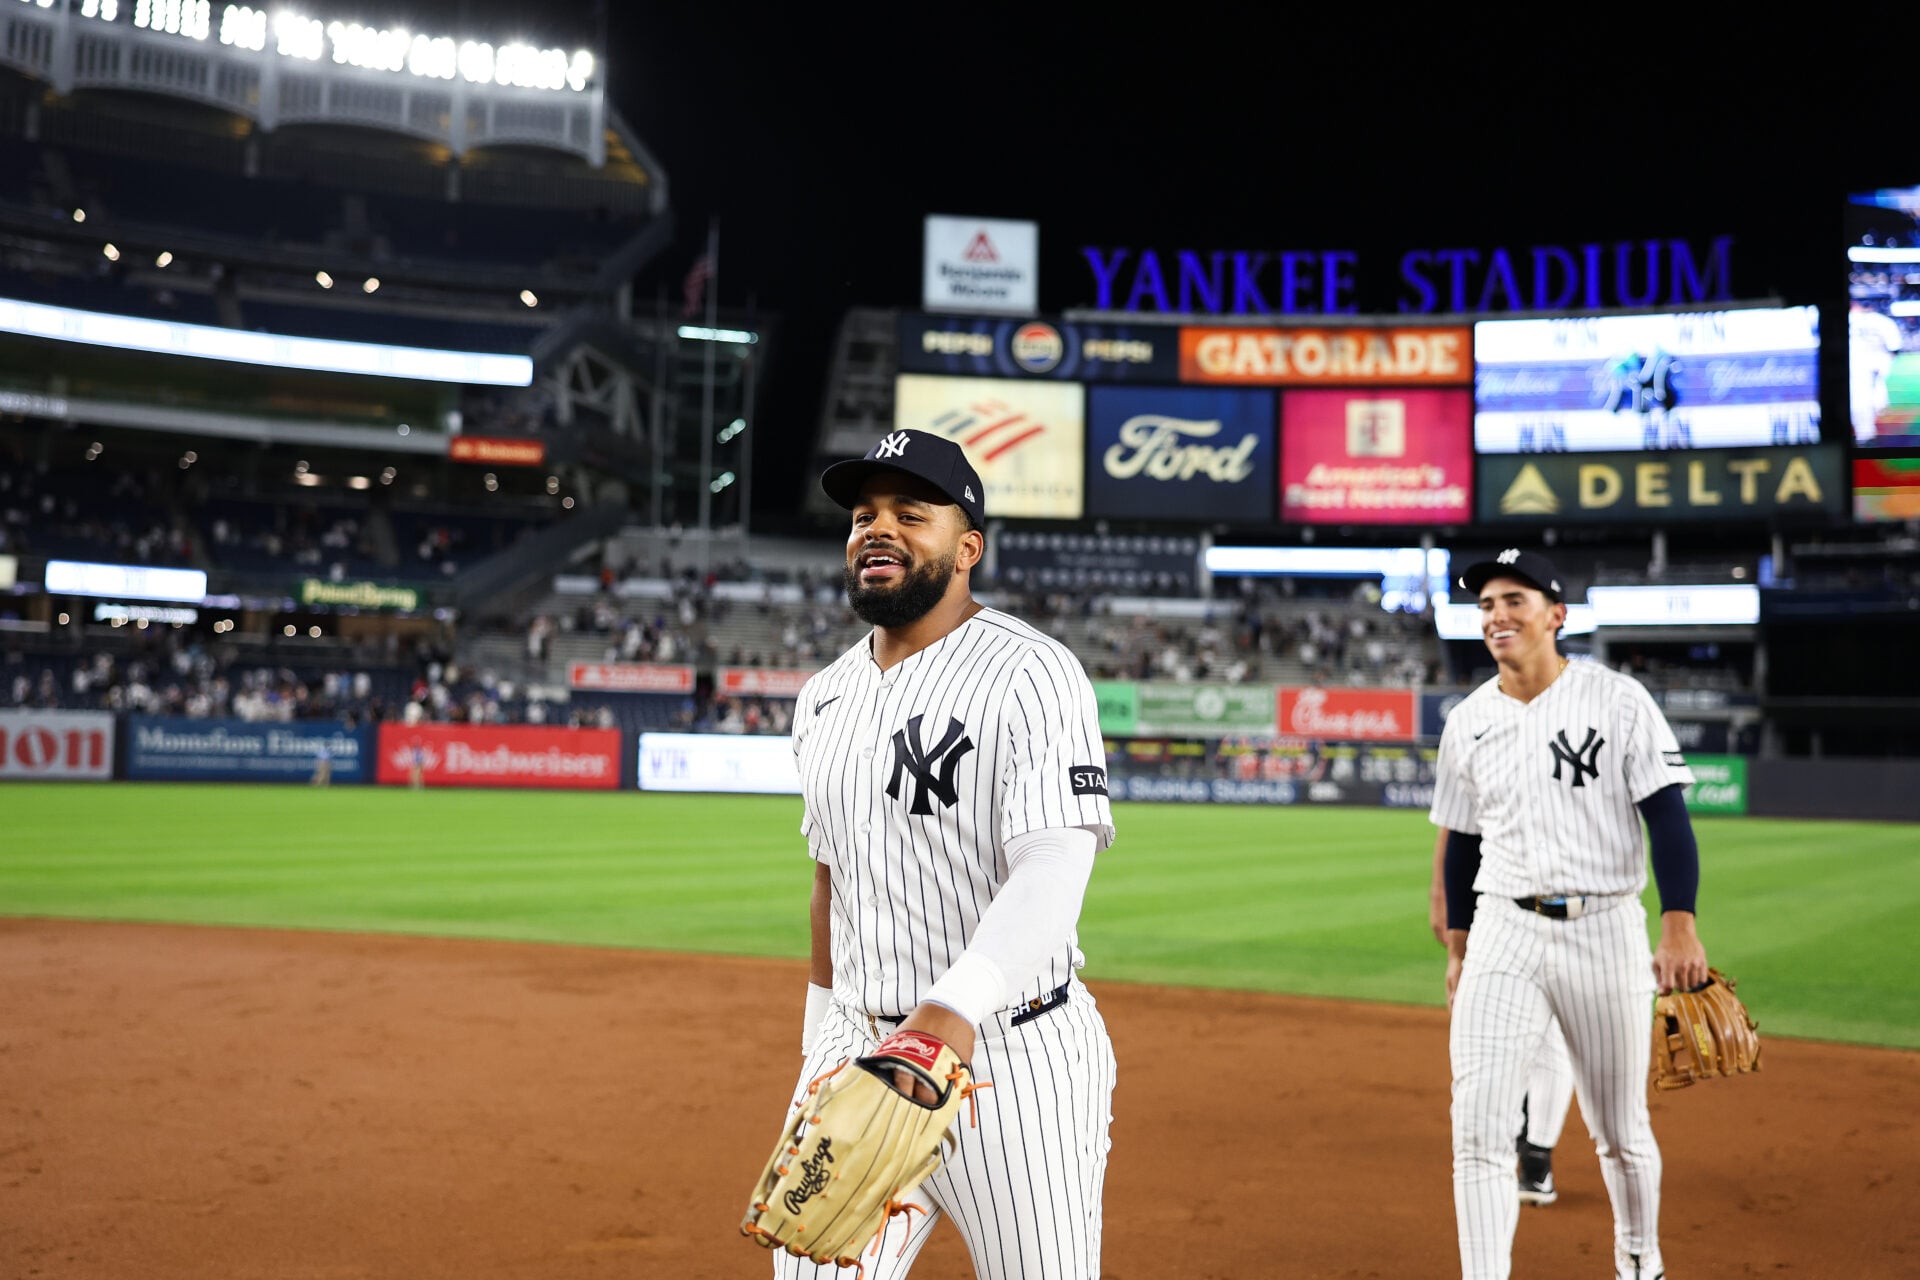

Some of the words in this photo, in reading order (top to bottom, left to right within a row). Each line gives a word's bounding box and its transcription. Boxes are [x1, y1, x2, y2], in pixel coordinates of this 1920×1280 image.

[1081, 247, 1360, 315] YANKEE
[1399, 235, 1735, 315] STADIUM
[922, 330, 994, 356] PEPSI
[1196, 334, 1461, 376] GATORADE
[875, 431, 911, 459] NY
[1102, 414, 1260, 483] Ford
[1578, 457, 1823, 508] DELTA
[443, 739, 609, 778] Budweiser
[885, 713, 975, 816] NY
[1074, 772, 1107, 790] STA
[1547, 726, 1606, 787] NY
[783, 1135, 833, 1216] Rawlings
